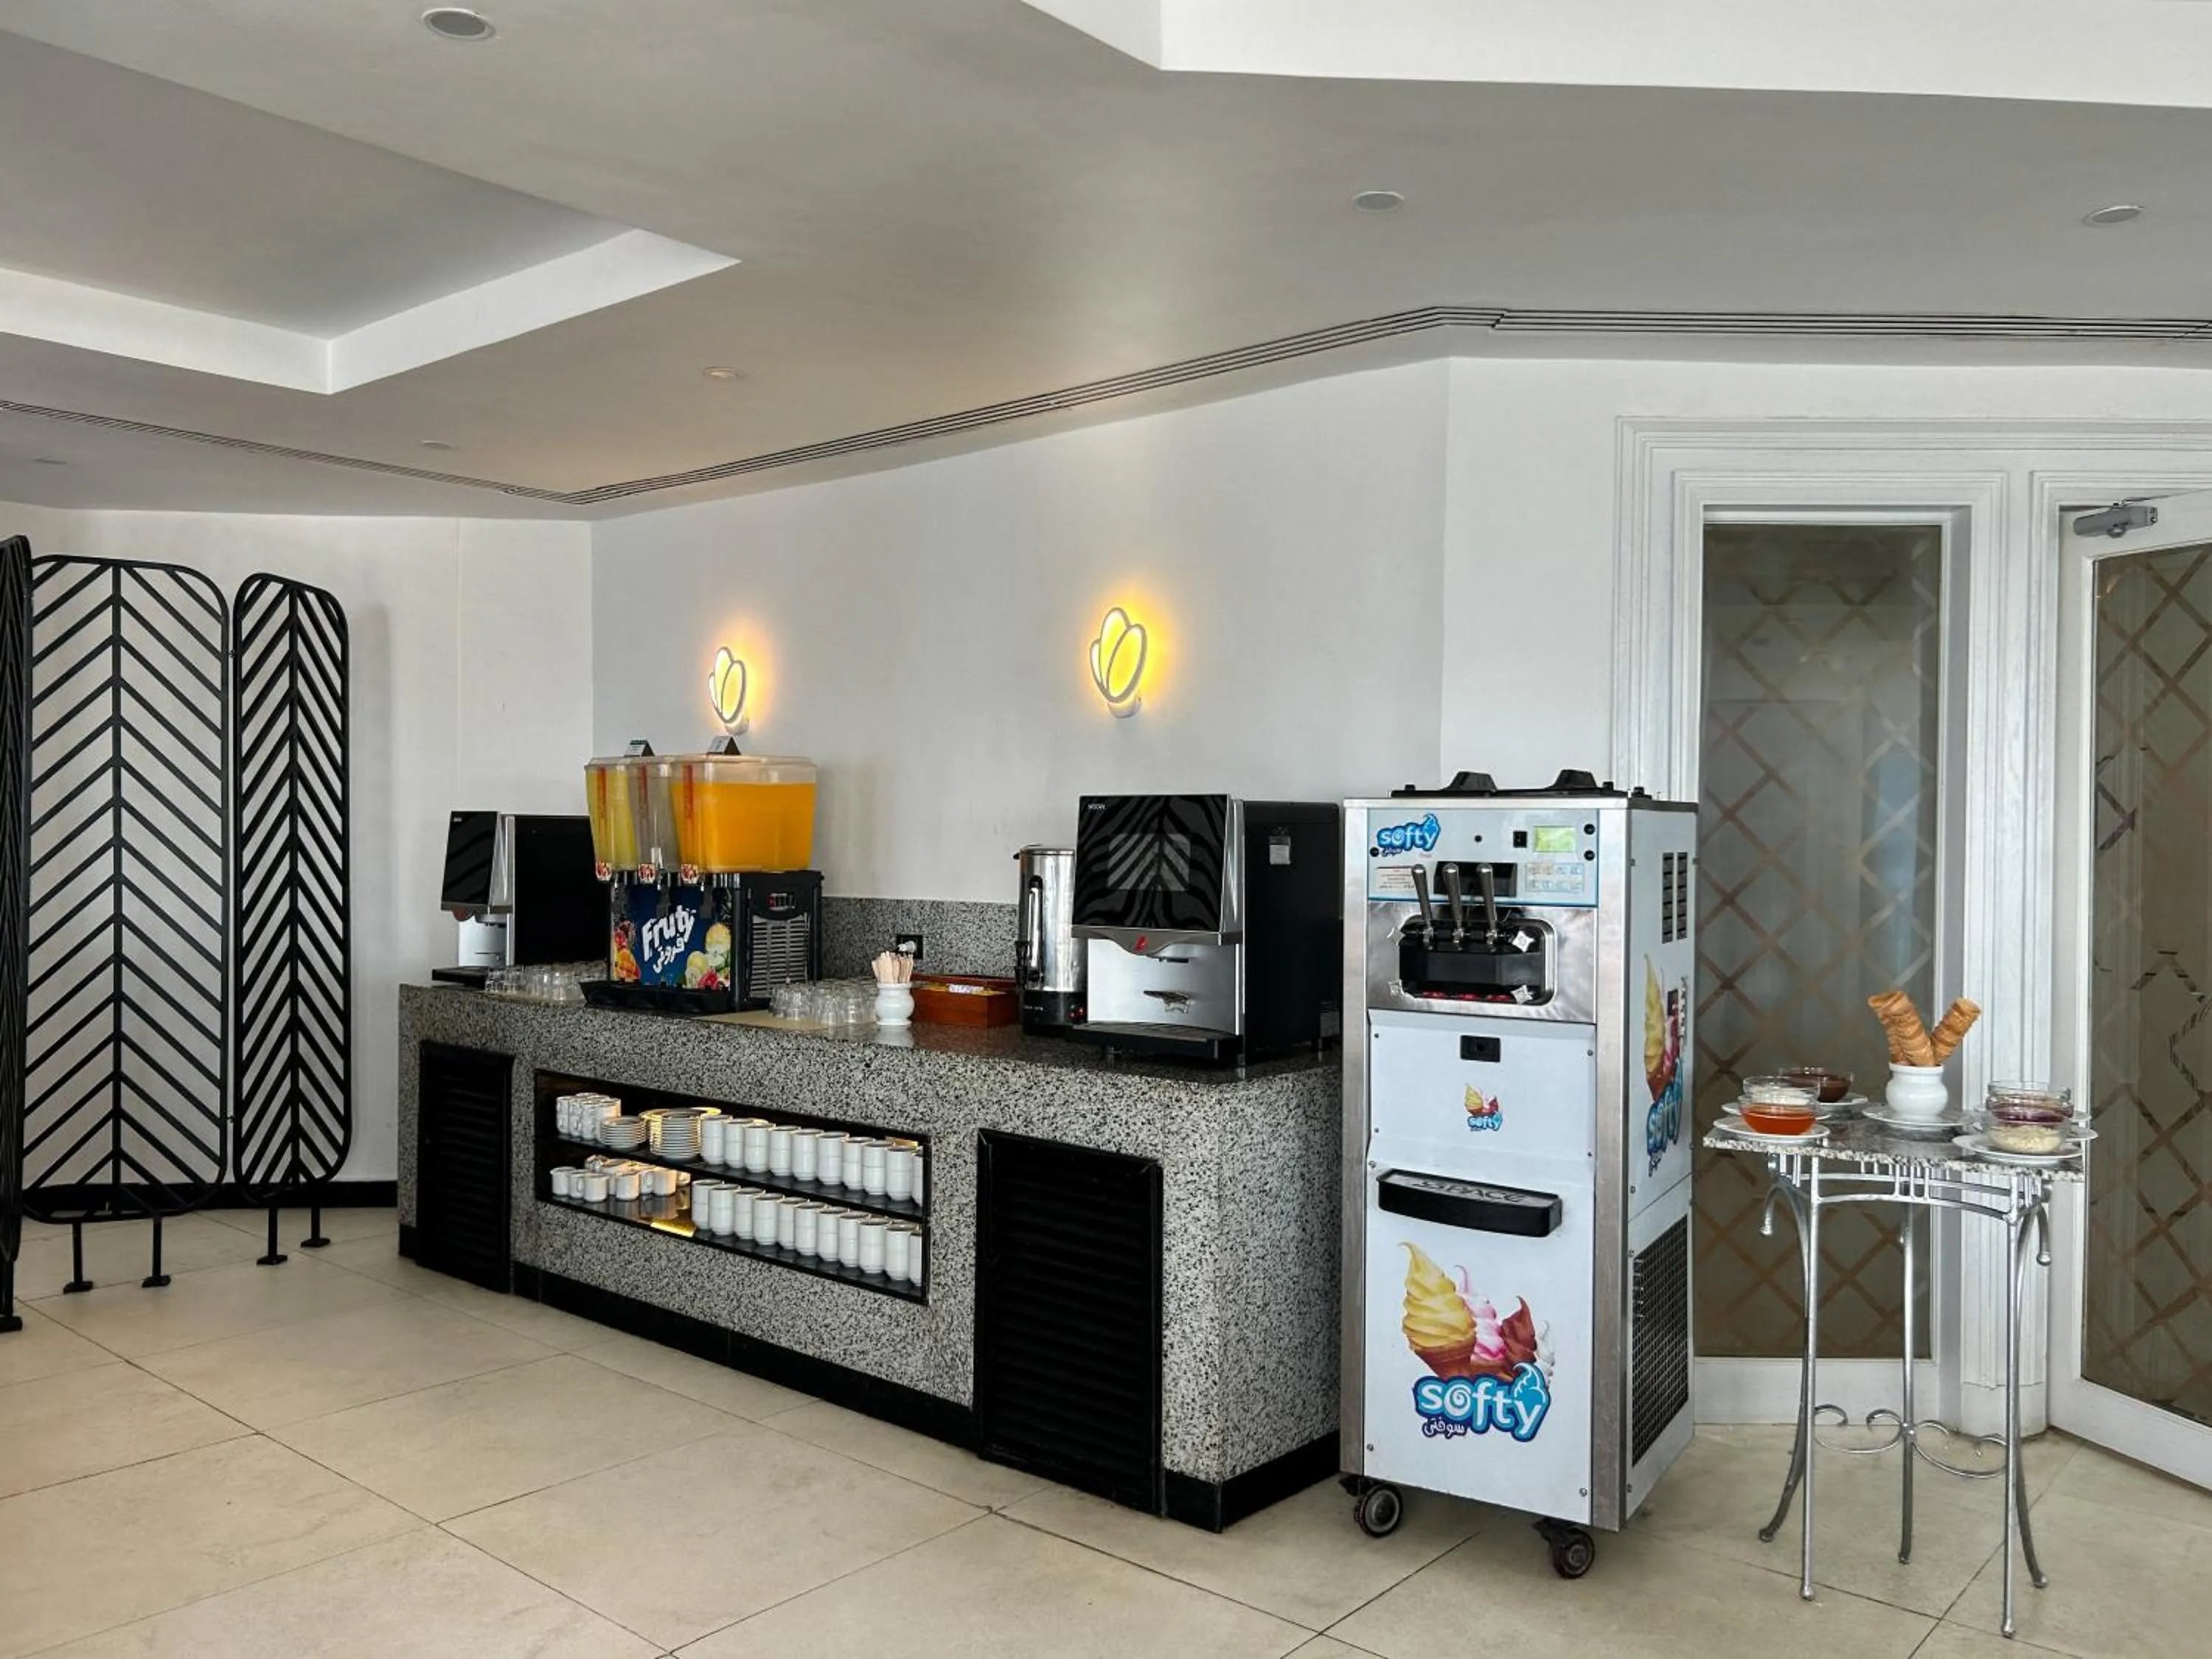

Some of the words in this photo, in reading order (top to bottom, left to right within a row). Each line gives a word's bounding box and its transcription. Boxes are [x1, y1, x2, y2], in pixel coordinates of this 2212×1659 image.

[1379, 824, 1438, 849] softy
[642, 905, 697, 961] Fruty
[1417, 1377, 1545, 1437] softy
